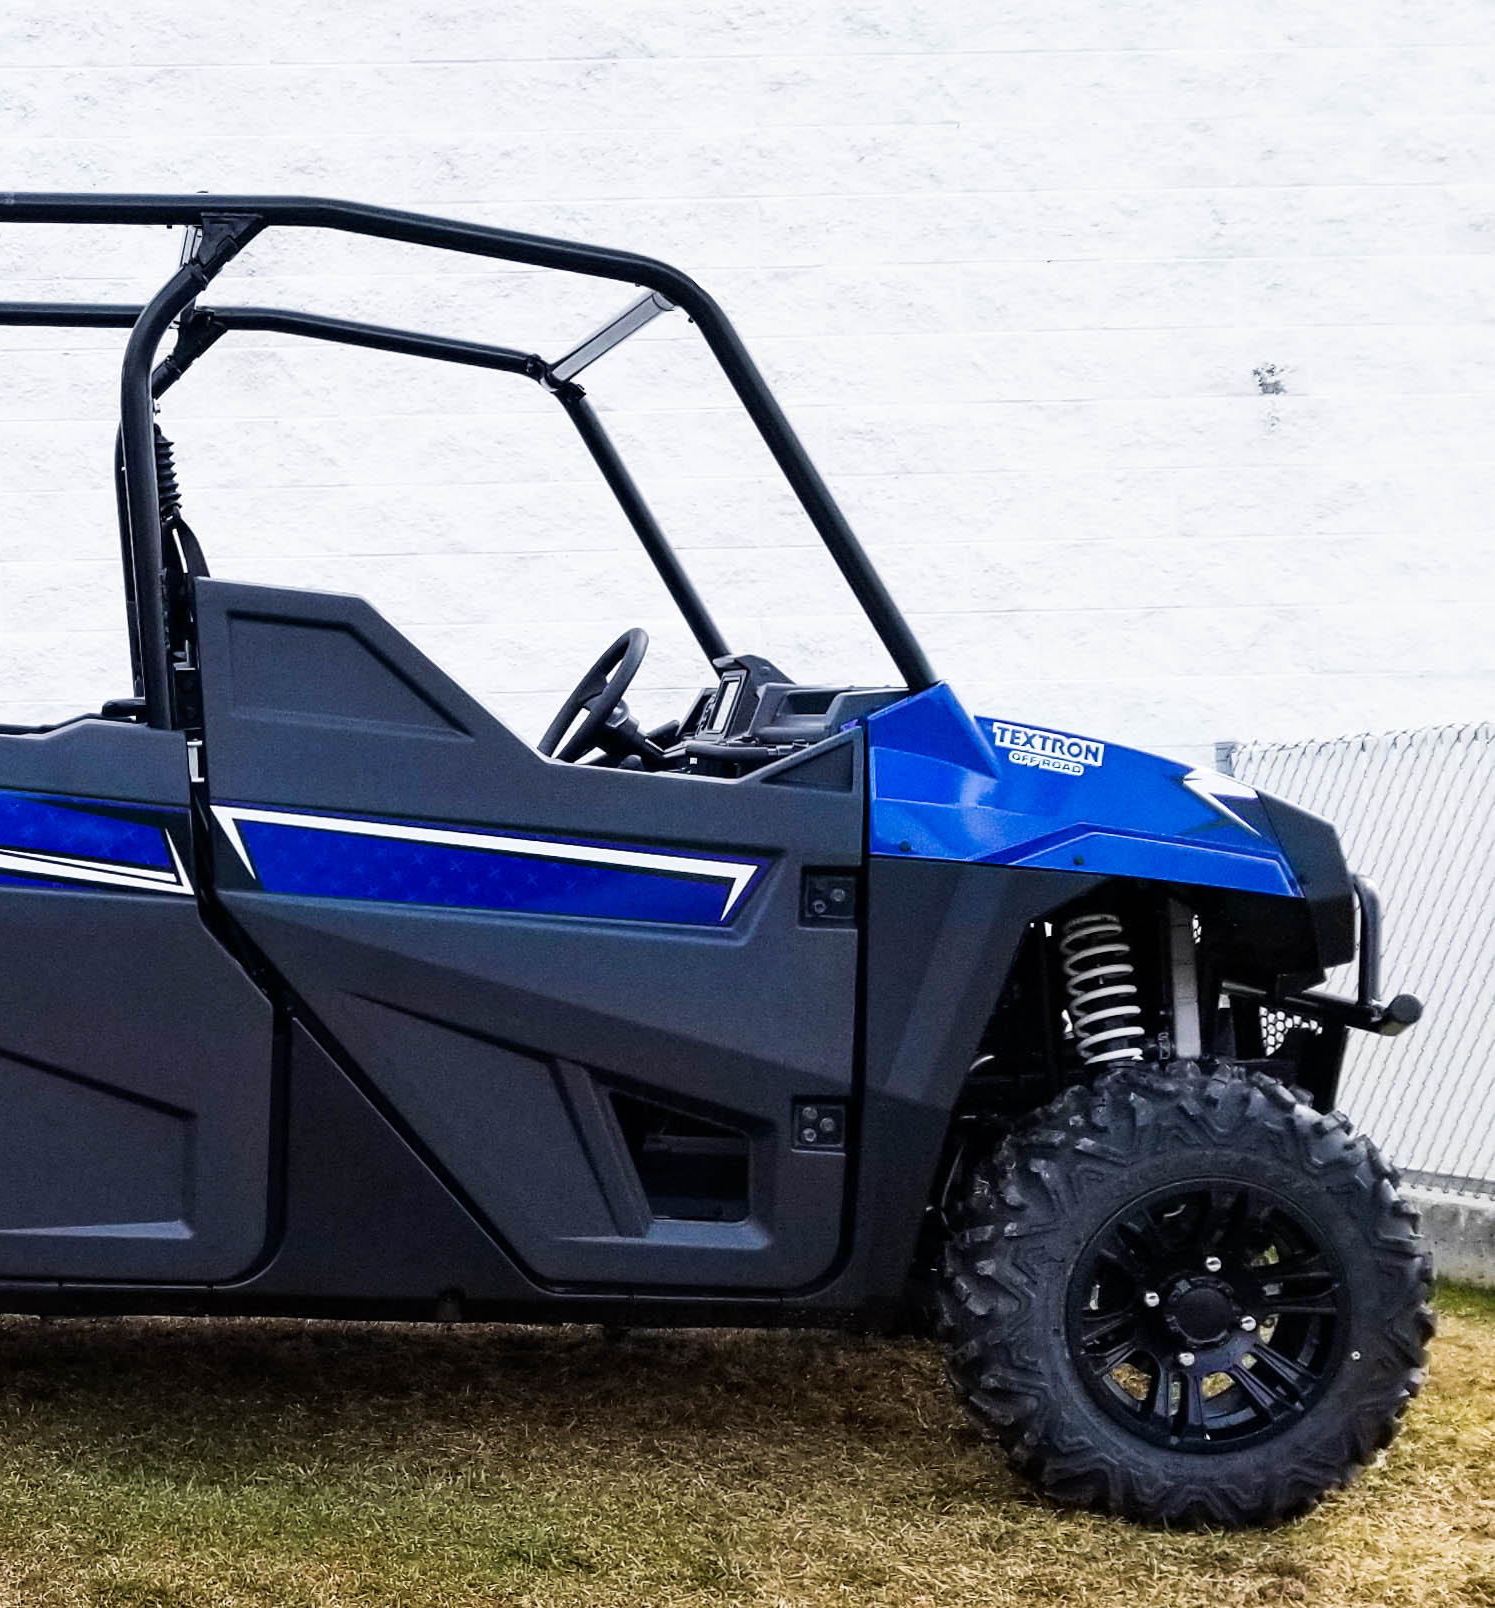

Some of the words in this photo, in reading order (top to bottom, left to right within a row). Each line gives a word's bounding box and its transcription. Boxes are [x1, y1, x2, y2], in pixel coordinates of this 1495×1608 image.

[996, 726, 1100, 762] TEXTRON
[1011, 752, 1038, 765] OFF
[1042, 759, 1081, 773] ROAD
